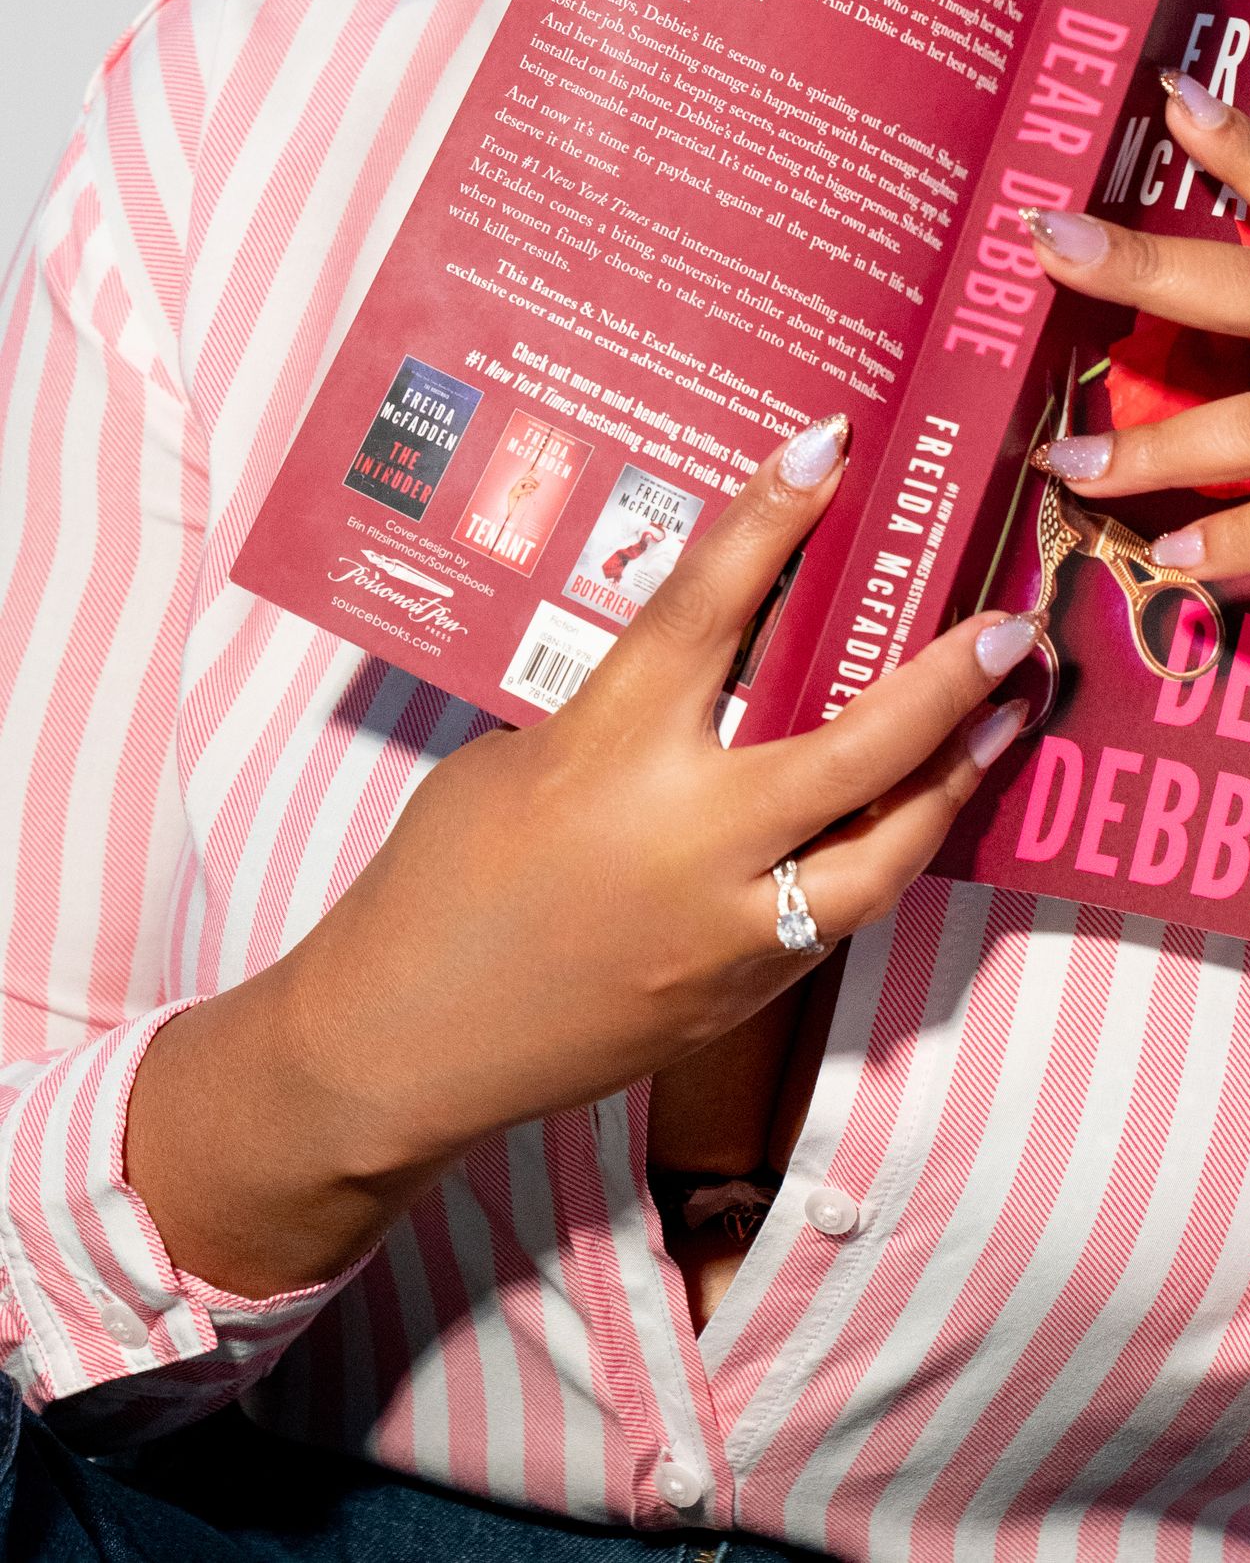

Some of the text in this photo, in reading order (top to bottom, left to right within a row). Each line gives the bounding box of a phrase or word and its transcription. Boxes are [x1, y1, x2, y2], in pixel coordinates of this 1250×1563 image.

[854, 4, 898, 38] Debbie
[519, 54, 716, 160] being reasonable practical.
[540, 12, 921, 211] And husband keeping secrets, according tracking
[628, 25, 830, 135] Something strange happening
[727, 48, 767, 74] seems
[805, 86, 860, 122] spiraling
[897, 132, 935, 160] control.
[1016, 7, 1130, 155] DEAR
[494, 106, 544, 140] deserve
[529, 33, 864, 203] installed phone. done being bigger
[504, 85, 852, 262] And payback against people
[469, 156, 824, 341] McFadden comes biting, subversive thriller about
[480, 134, 877, 341] From New York Times international bestselling author
[482, 217, 570, 272] killer results.
[460, 182, 820, 366] when women finally choose justice into their
[445, 262, 760, 423] exclusive cover and extra advice column from
[497, 258, 811, 424] This Barnes Noble Exclusive Edition features
[379, 401, 458, 451] McFADDEN
[401, 387, 456, 426] FREIDA
[464, 349, 487, 371] #1
[484, 359, 514, 384] New
[512, 372, 542, 398] York
[540, 386, 578, 416] Times
[576, 403, 644, 453] bestselling
[642, 440, 684, 468] author
[682, 456, 721, 488] Freida
[511, 341, 549, 372] Check
[548, 363, 571, 383] out
[569, 373, 602, 398] more
[601, 388, 683, 440] mind-bending
[681, 425, 731, 461] thrillers
[730, 448, 758, 474] from
[353, 452, 434, 504] INTRUDER
[386, 440, 422, 471] THE
[505, 436, 572, 479] McFADDEN
[523, 427, 570, 460] FREIDA
[888, 415, 960, 535] FREIDA
[346, 515, 365, 532] Erin
[618, 492, 684, 534] McFADDEN
[635, 482, 681, 514] FREIDA
[385, 519, 469, 569] Cover design by
[461, 512, 537, 567] TENANT
[328, 556, 468, 634] Poisoned Pen
[570, 574, 641, 622] BOYFRIEN
[878, 482, 960, 679] #1 NEW YORK TIMES BESTSELLING AUTHO
[331, 595, 441, 657] sourcebooks.com
[424, 625, 452, 643] PRESS
